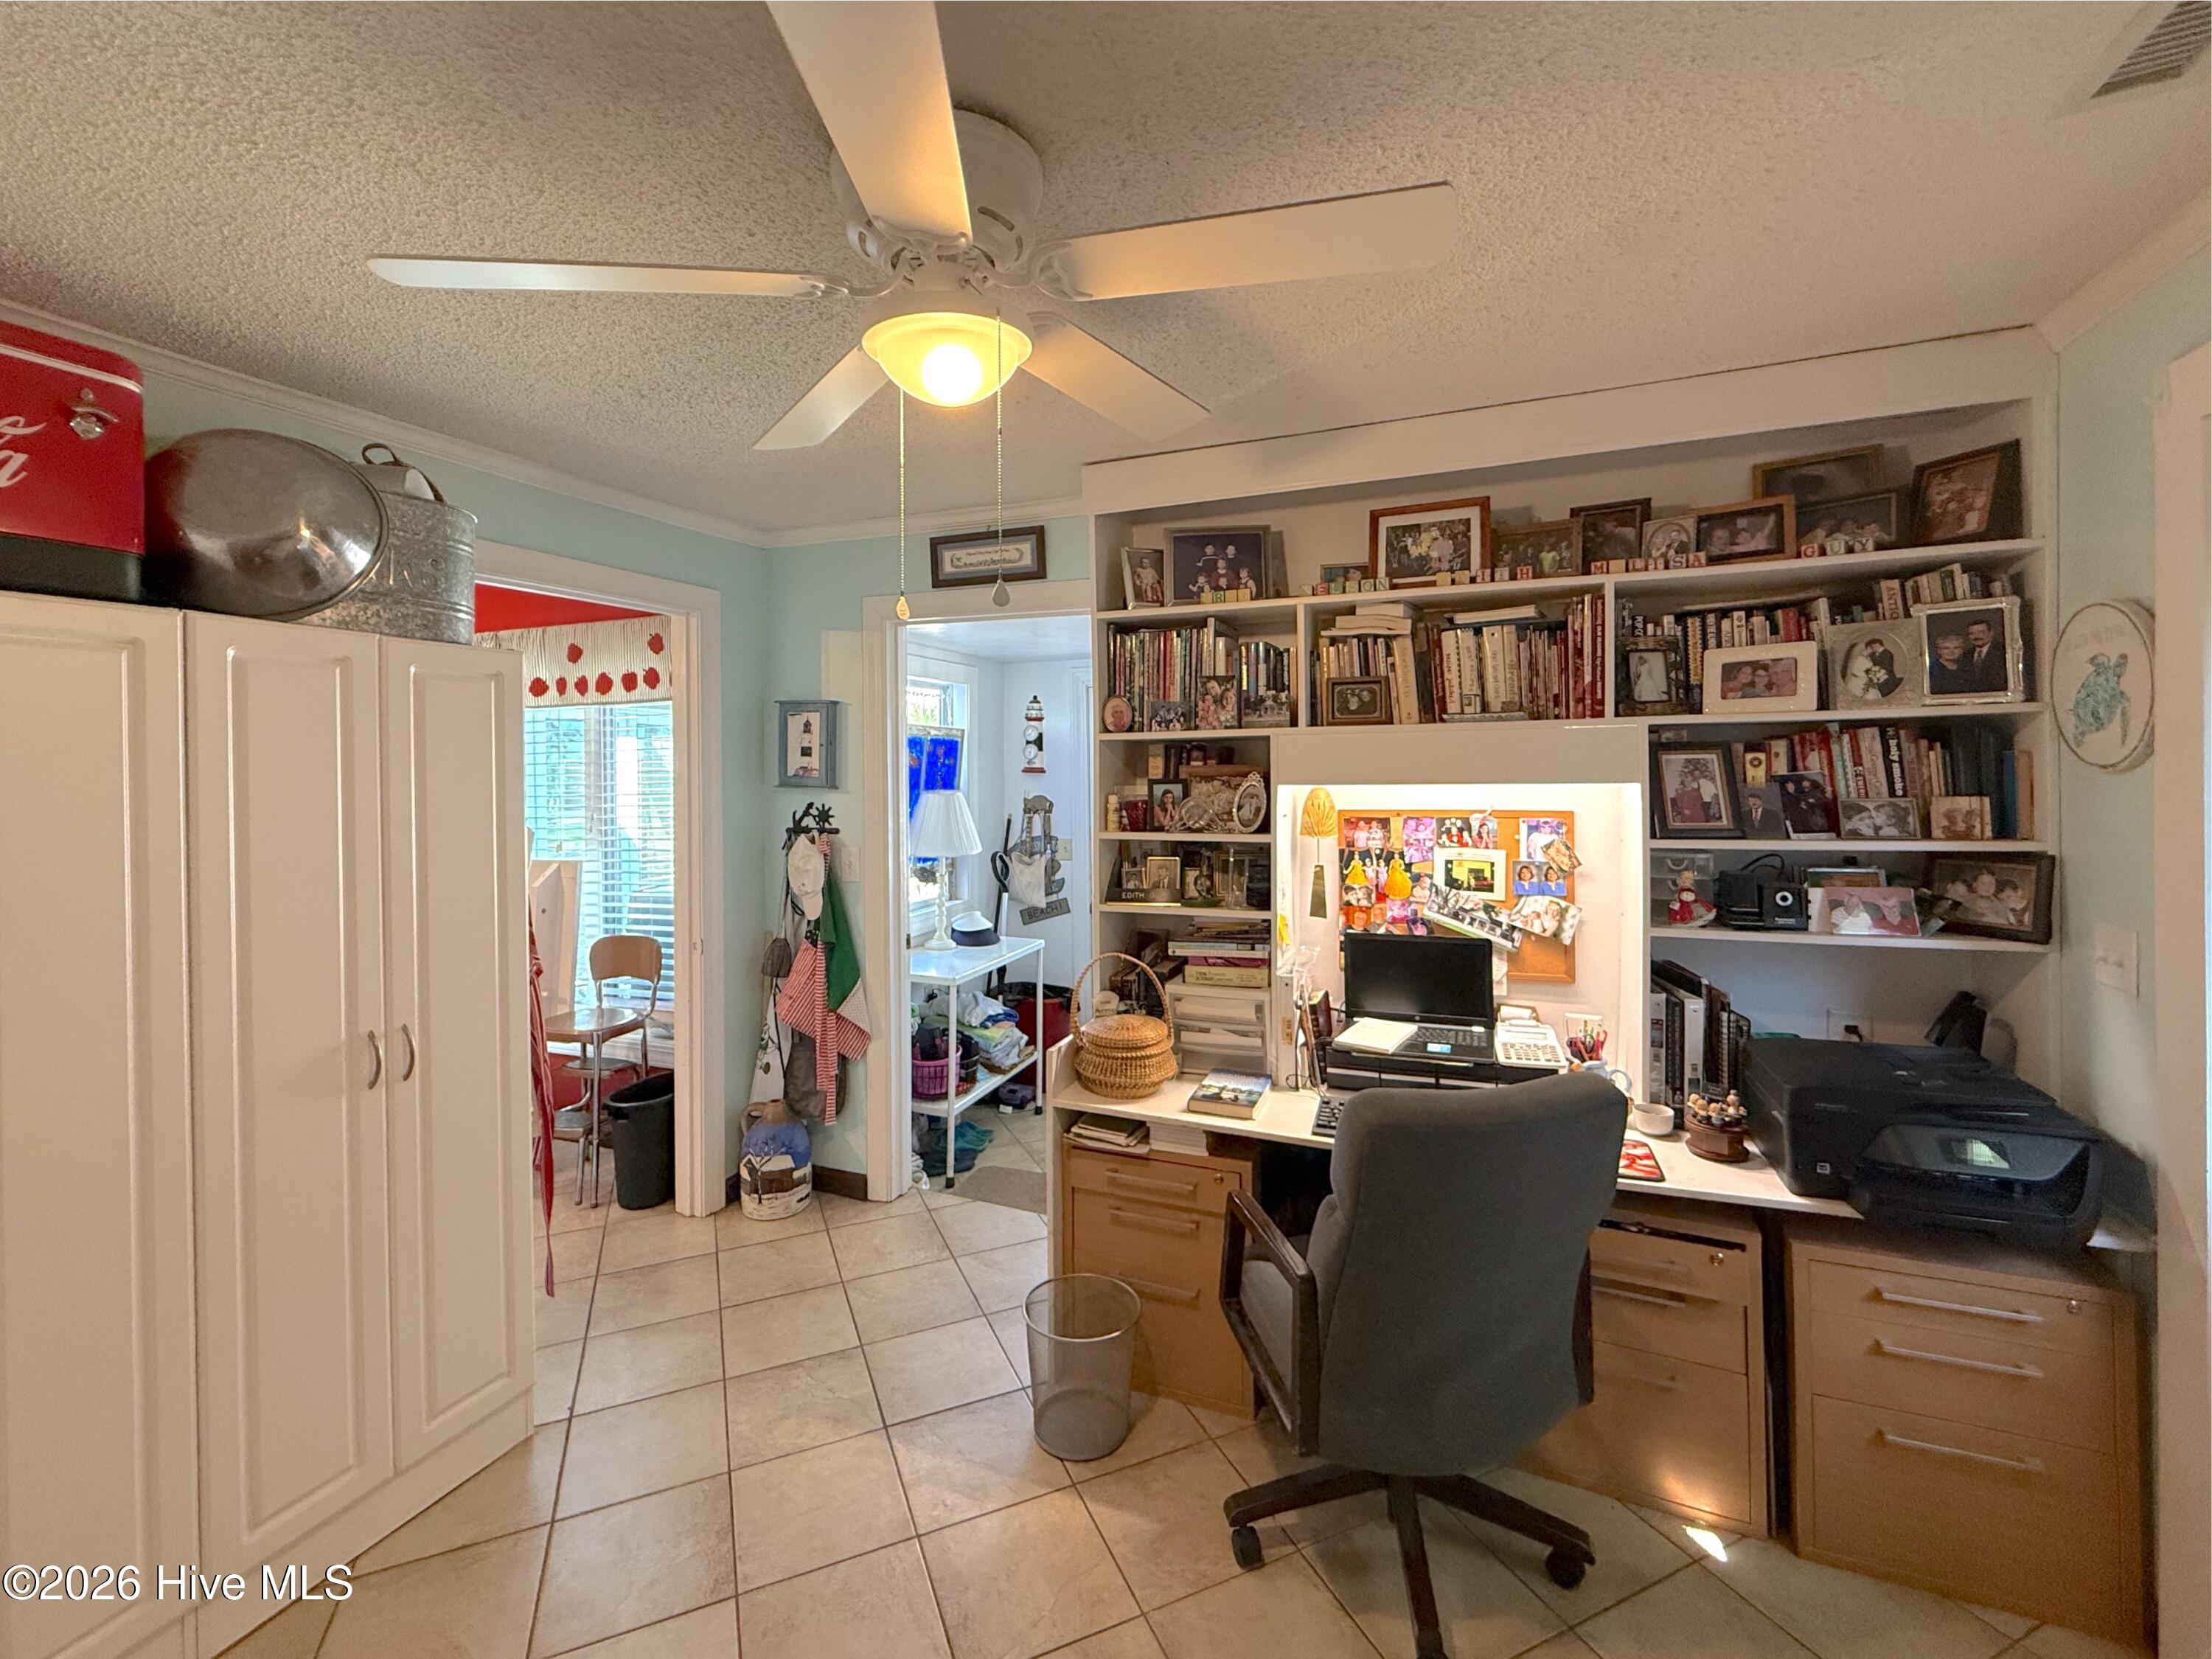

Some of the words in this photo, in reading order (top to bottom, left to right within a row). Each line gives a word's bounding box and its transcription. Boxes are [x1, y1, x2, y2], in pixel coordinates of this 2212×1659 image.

[1802, 537, 1874, 557] GUY
[1888, 740, 1899, 761] holy
[1891, 762, 1905, 796] smoke
[1027, 901, 1062, 919] BEACH!
